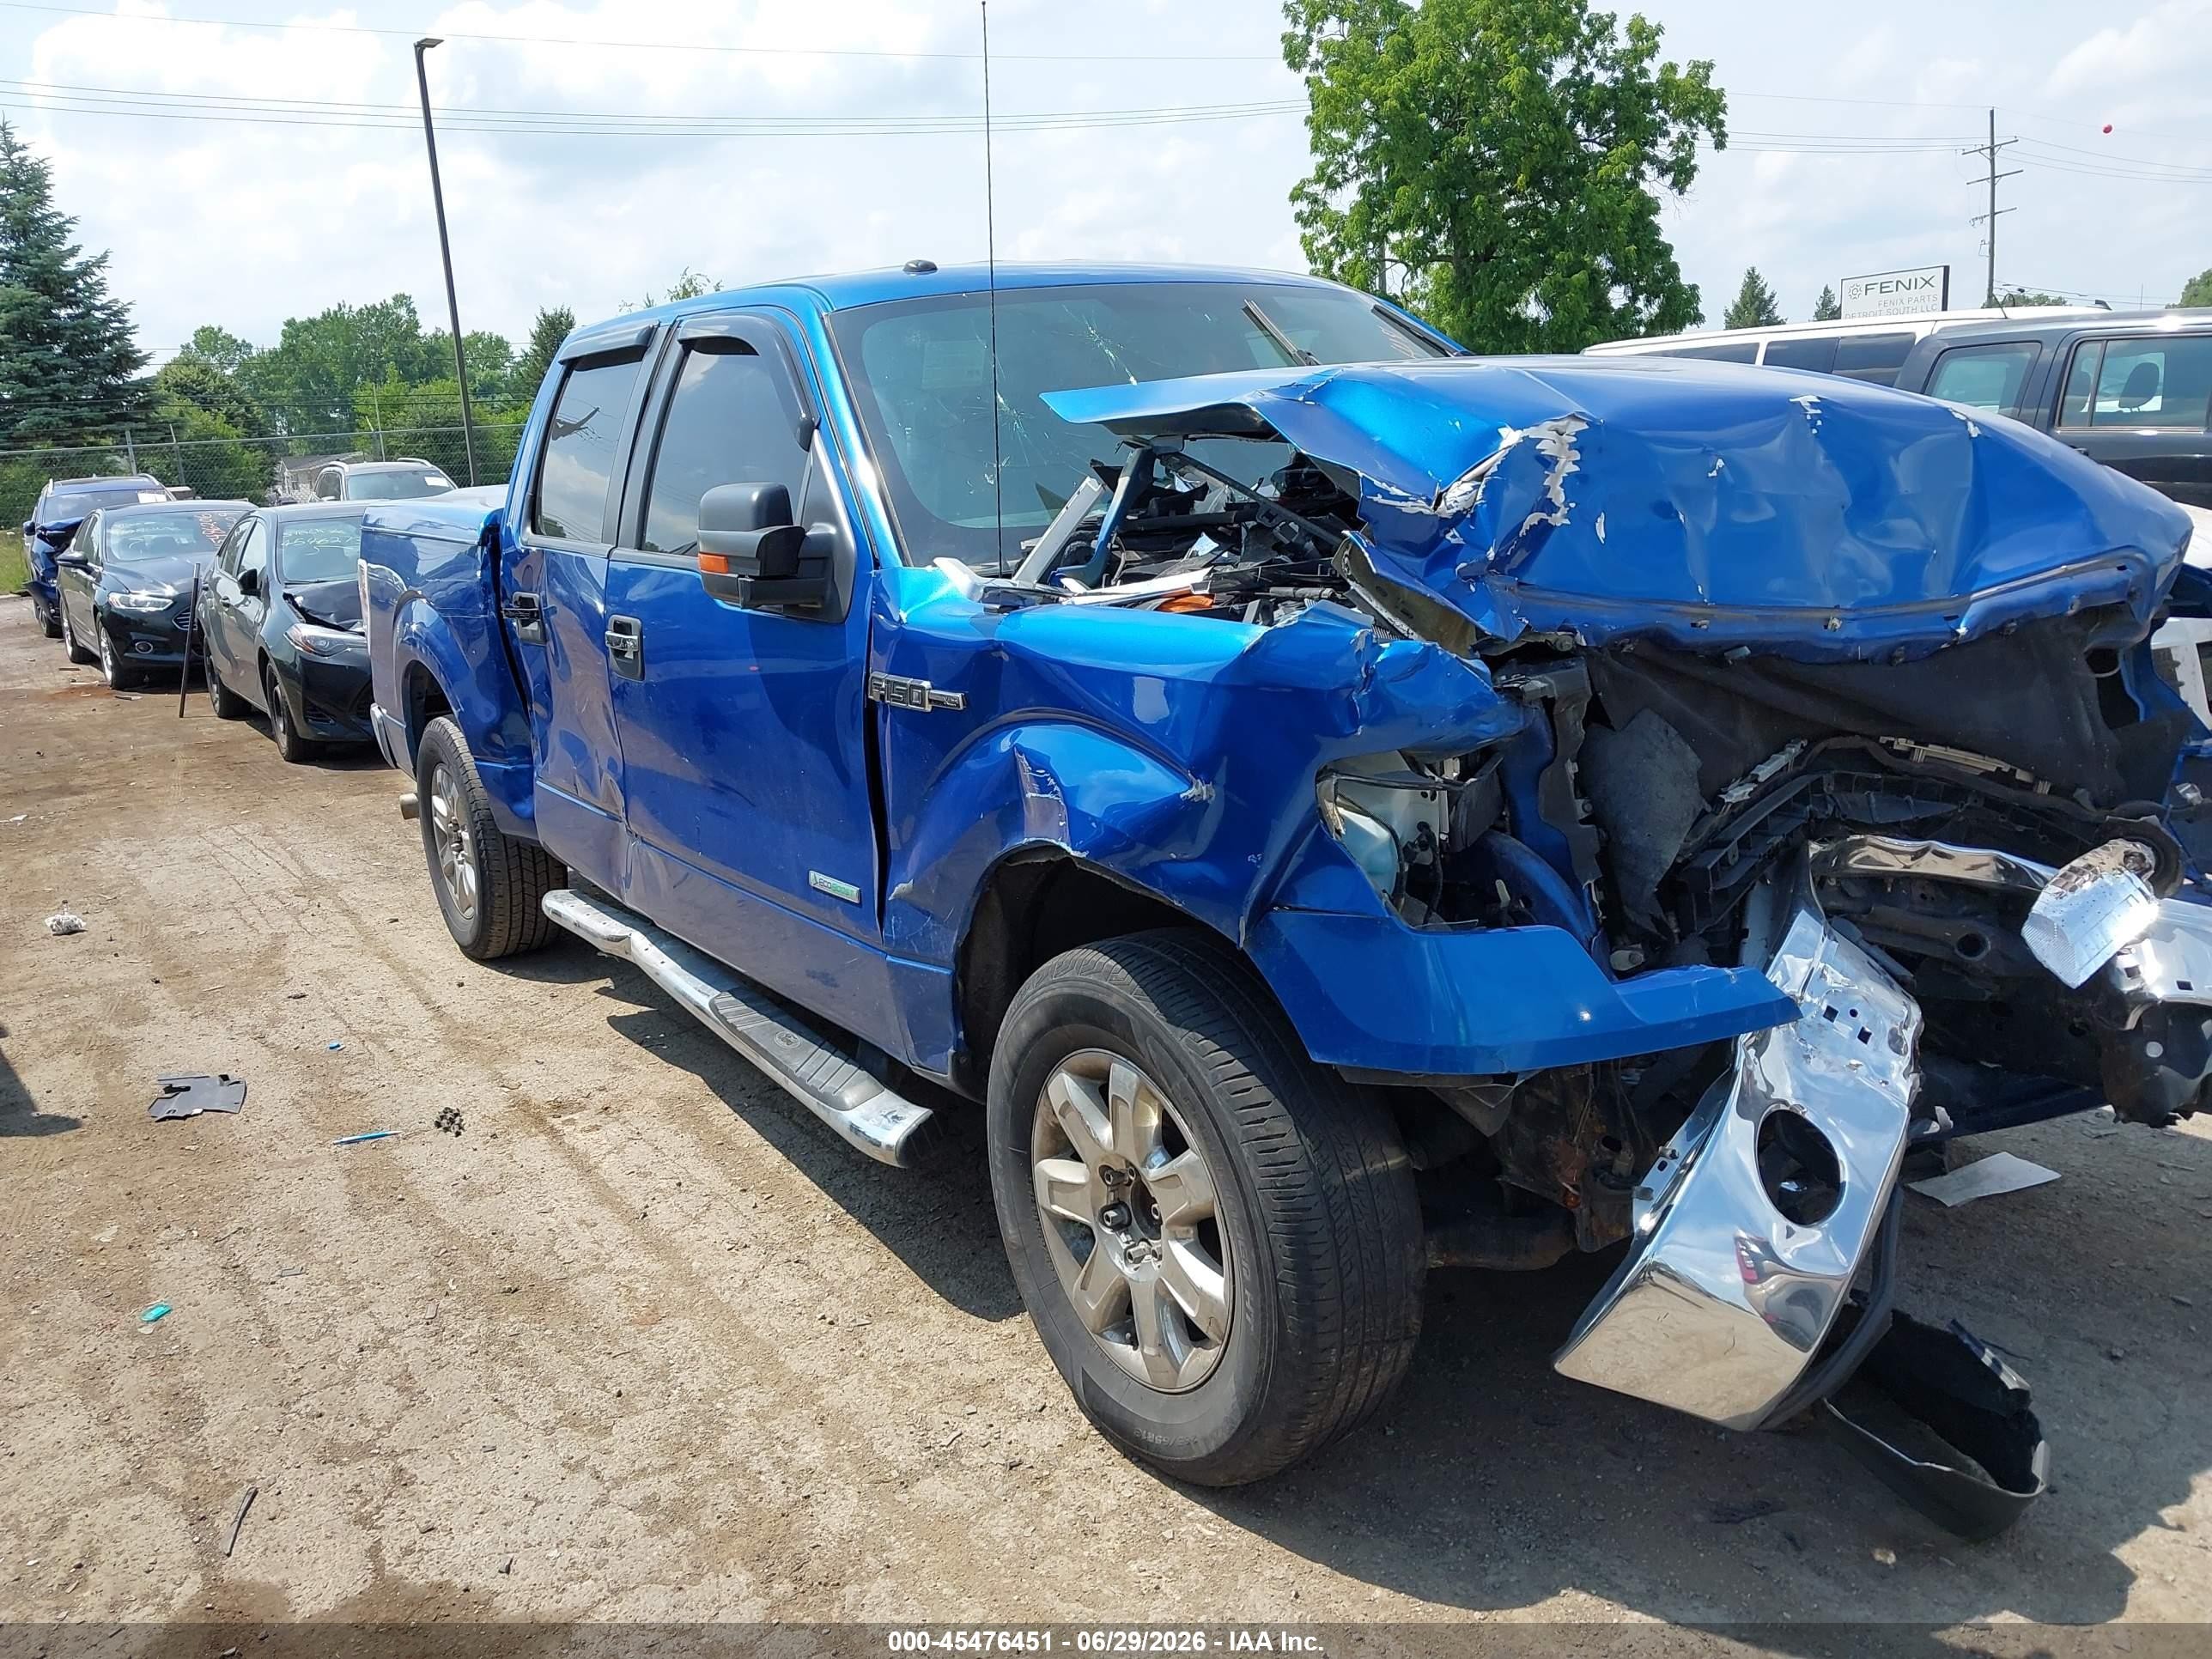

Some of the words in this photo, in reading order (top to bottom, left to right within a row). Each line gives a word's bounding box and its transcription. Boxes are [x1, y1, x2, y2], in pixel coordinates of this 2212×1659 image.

[1864, 275, 1936, 295] FENIX
[1878, 298, 1905, 307] FENIX
[1907, 294, 1938, 305] PARTS
[1886, 306, 1917, 316] SOUTH
[1920, 303, 1938, 313] LLC
